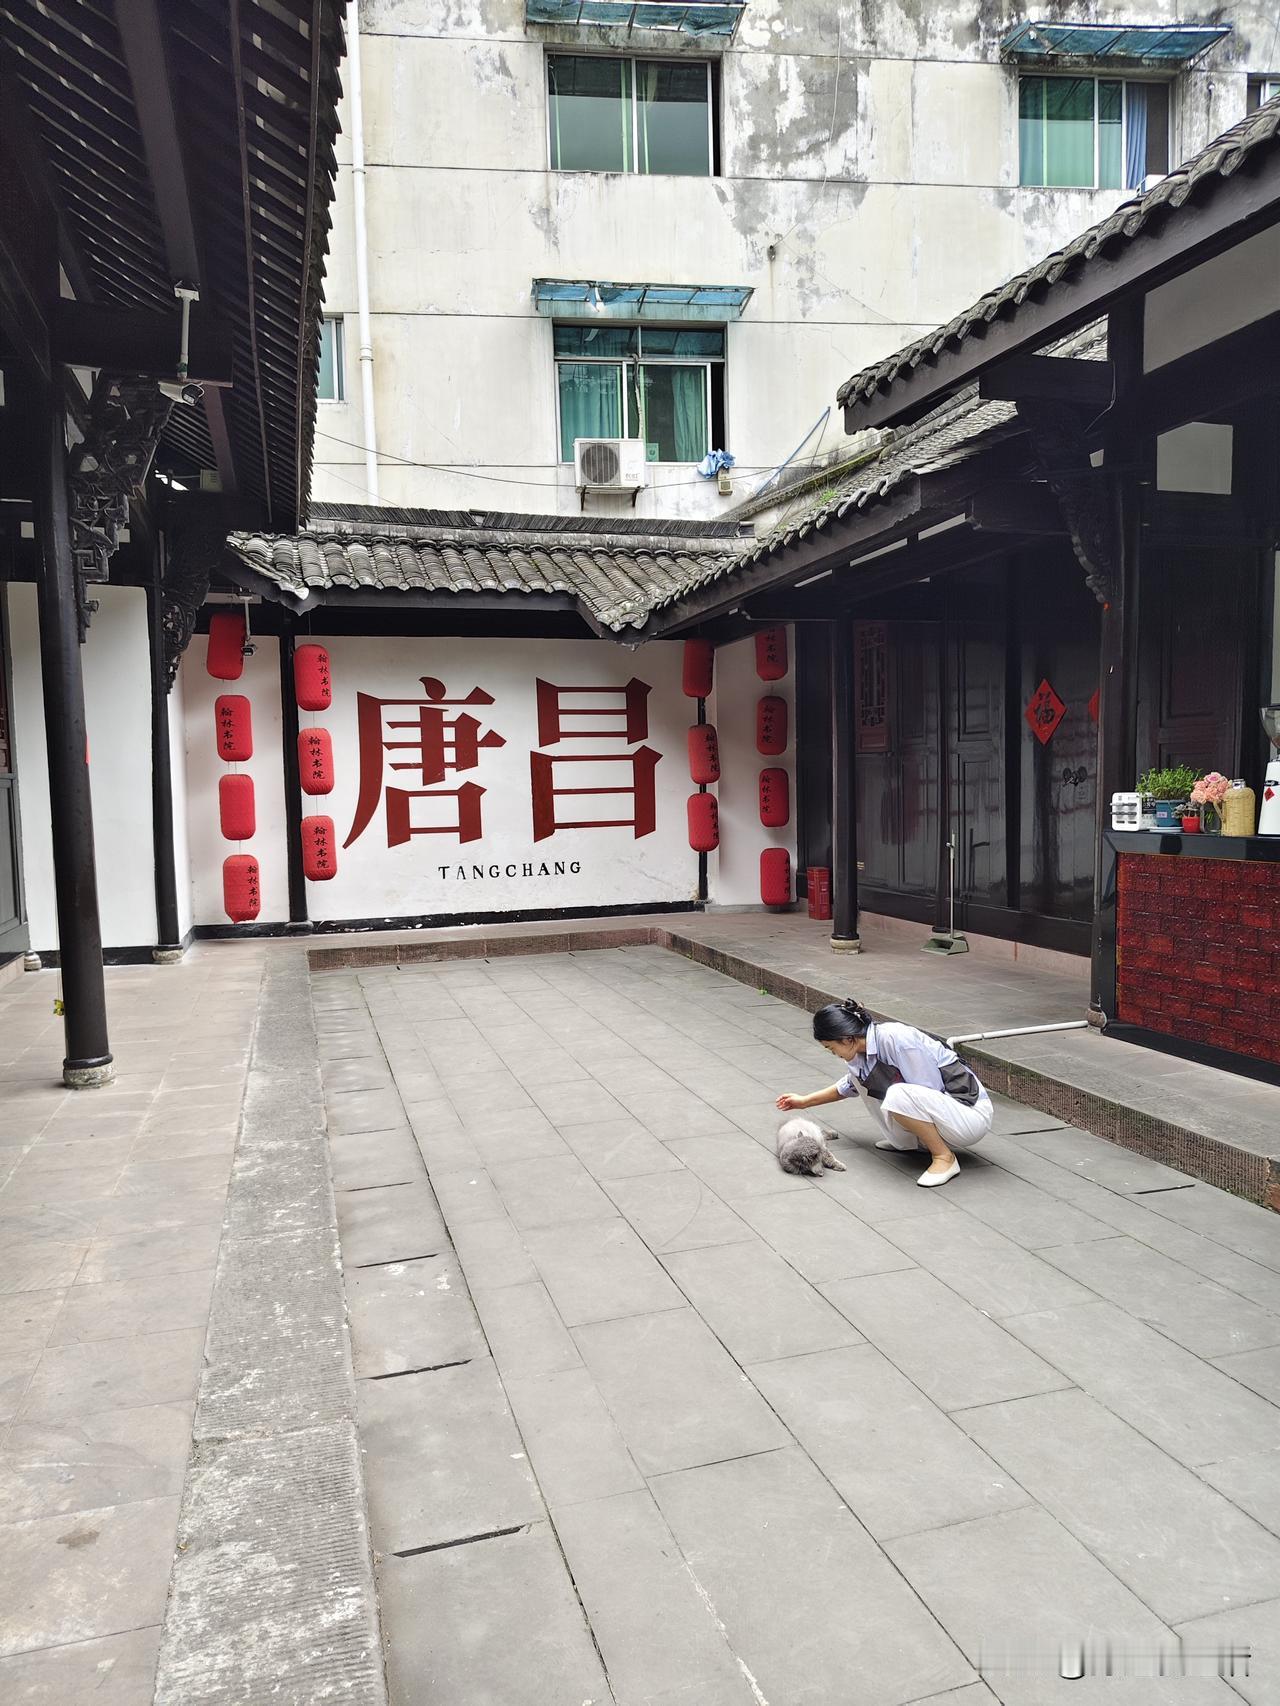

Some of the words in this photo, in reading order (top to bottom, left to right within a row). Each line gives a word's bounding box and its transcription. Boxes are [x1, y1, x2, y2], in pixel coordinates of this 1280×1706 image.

[317, 654, 331, 697] 翰林书院
[221, 707, 234, 750] 翰林书院
[763, 704, 775, 743] 翰林书院
[1034, 692, 1055, 726] 福
[308, 736, 326, 780] 翰林书院
[342, 676, 664, 849] 唐昌
[761, 776, 771, 813] 翰林书院
[314, 826, 330, 869] 翰林书院
[247, 865, 258, 907] 翰林书院
[438, 861, 582, 880] TANGCHANG
